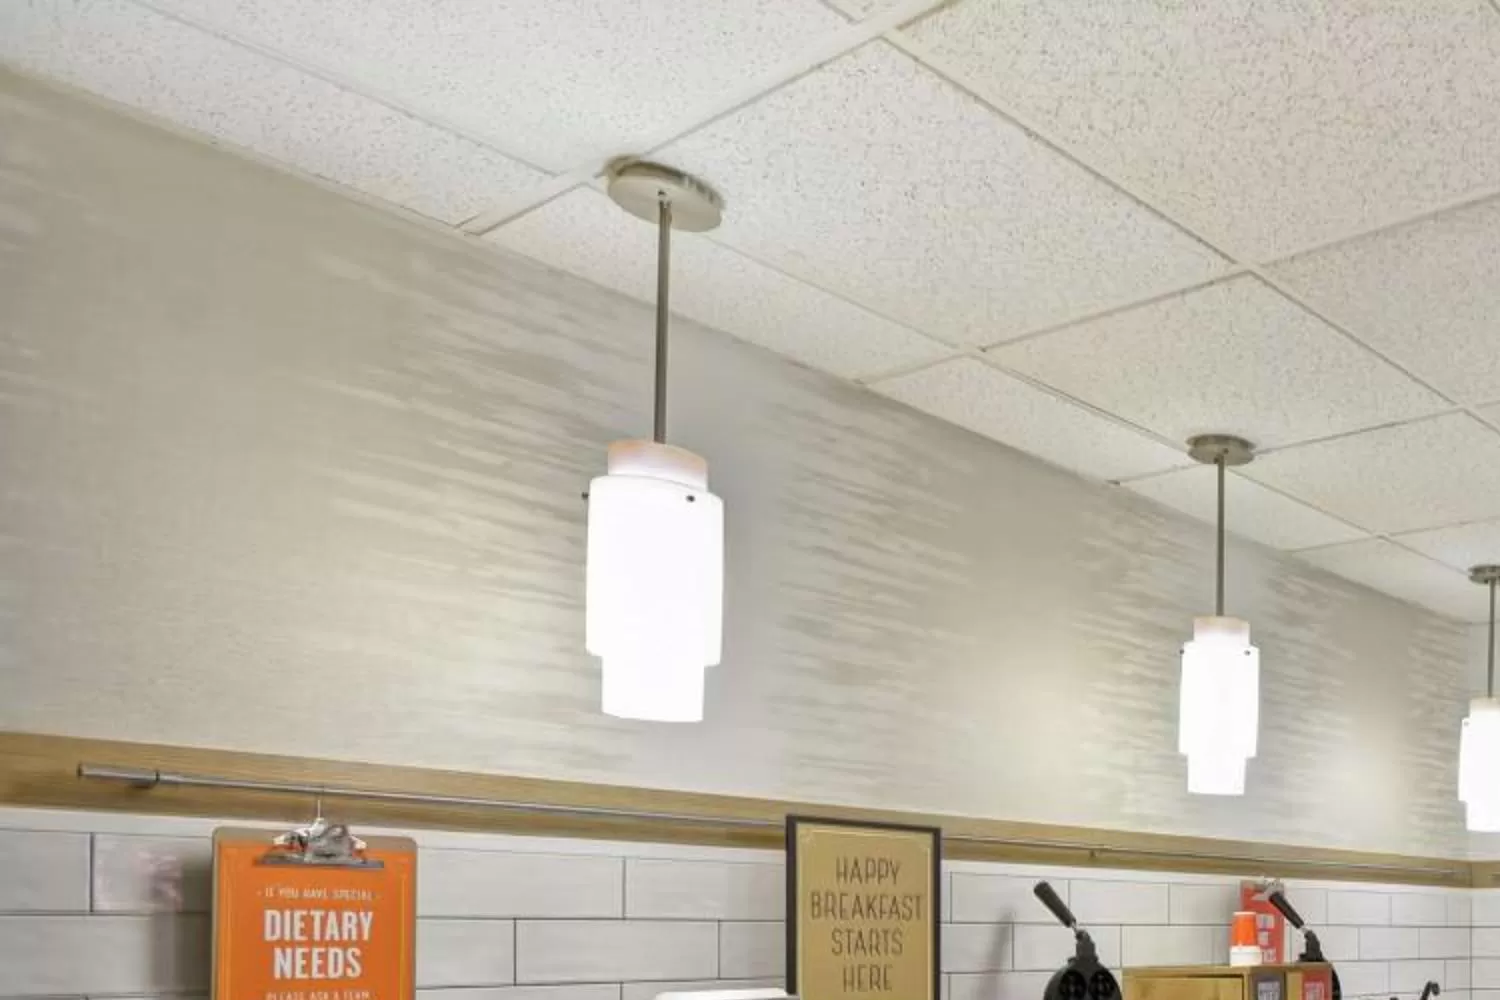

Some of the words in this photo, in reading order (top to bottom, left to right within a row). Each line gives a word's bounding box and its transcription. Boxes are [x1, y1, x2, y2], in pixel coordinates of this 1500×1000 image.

[836, 856, 900, 885] HAPPY
[811, 890, 924, 921] BREAKFAST
[263, 909, 373, 942] DIETARY
[831, 928, 903, 956] STARTS
[273, 947, 362, 980] NEEDS
[843, 964, 893, 993] HERE
